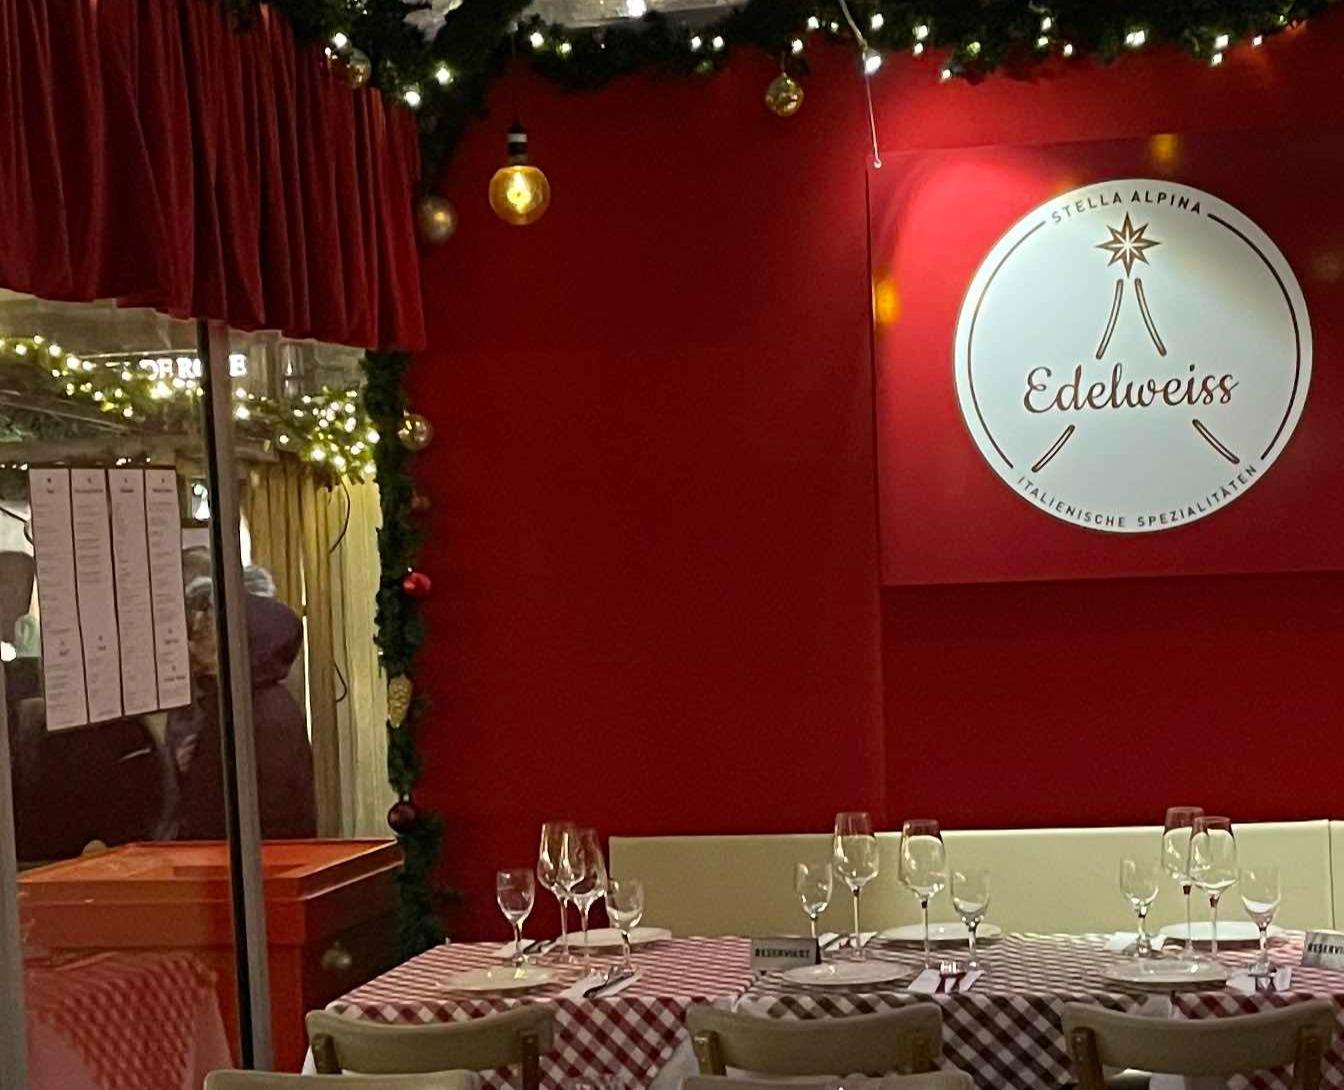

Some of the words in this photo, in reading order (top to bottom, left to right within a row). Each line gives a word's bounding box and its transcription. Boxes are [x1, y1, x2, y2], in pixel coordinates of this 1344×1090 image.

[1051, 192, 1122, 224] STELLA
[1130, 189, 1201, 215] ALPINA
[1022, 362, 1240, 414] Edelweiss
[1017, 475, 1126, 528] ITALIENISCHE
[1136, 465, 1257, 528] SPEZIALITÄTEN
